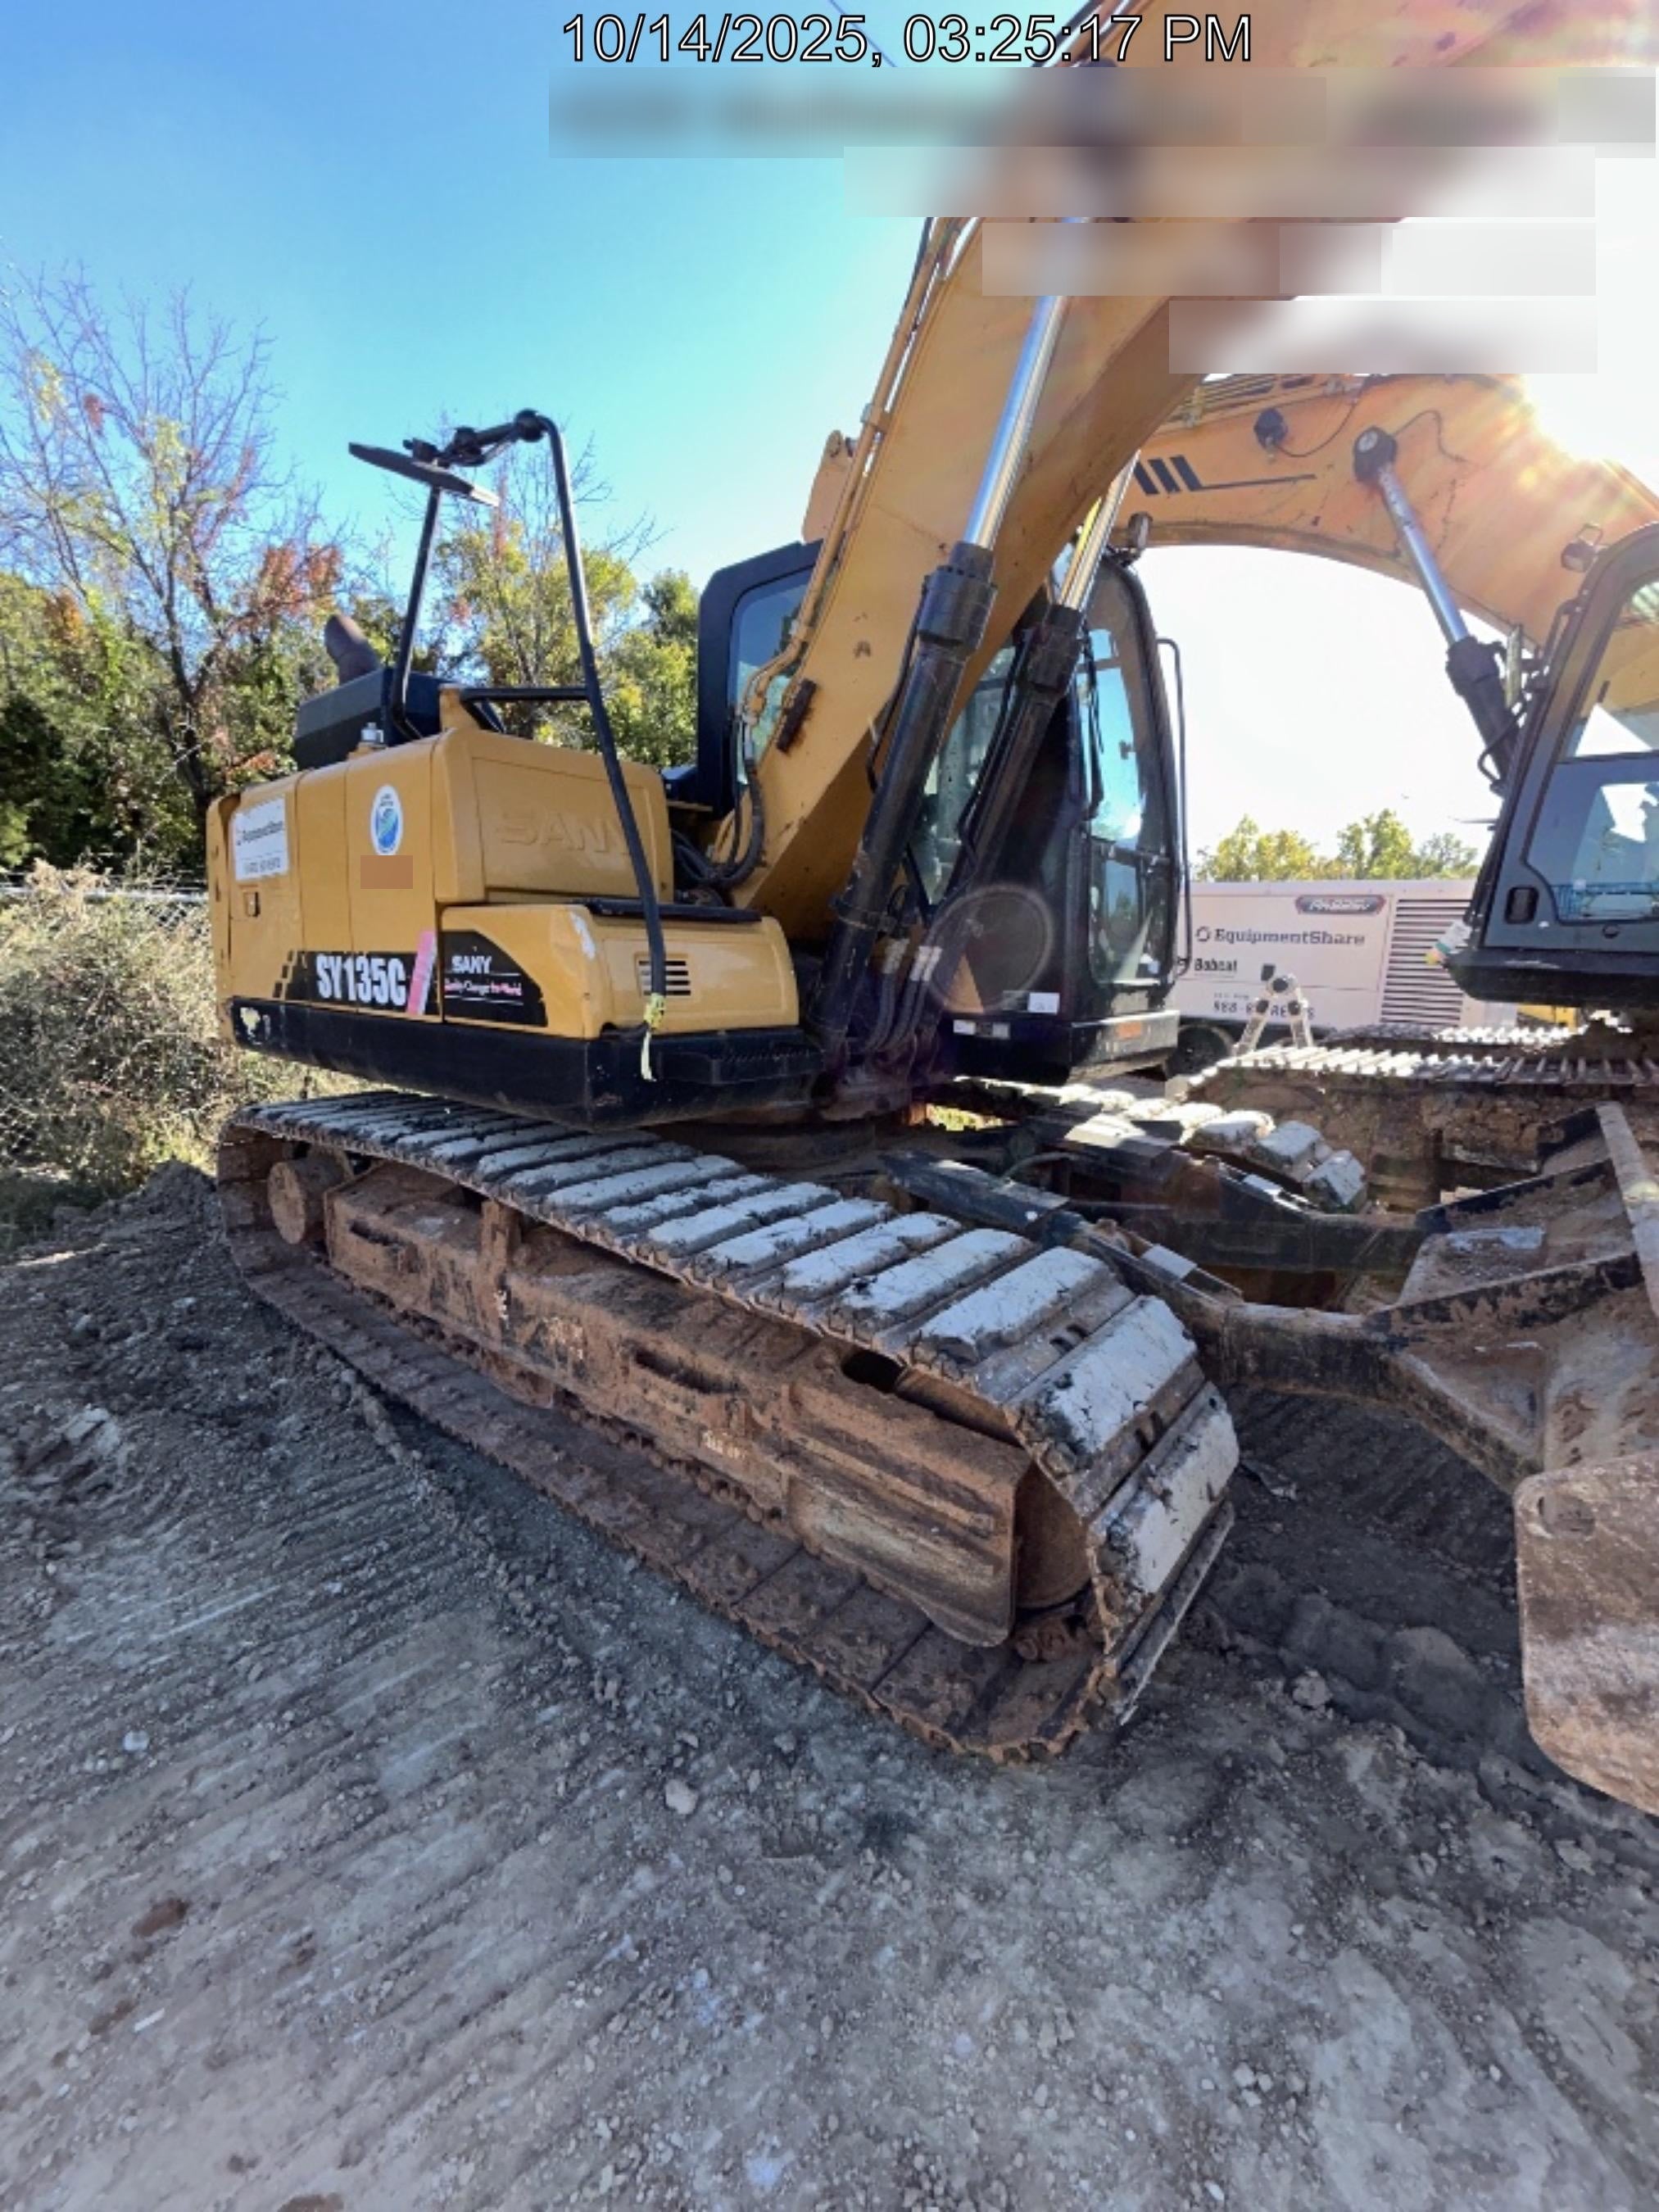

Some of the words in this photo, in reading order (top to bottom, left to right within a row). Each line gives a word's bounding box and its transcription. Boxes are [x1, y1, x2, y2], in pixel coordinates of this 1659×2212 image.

[1214, 927, 1366, 945] EquipmentShare
[451, 955, 492, 974] SANY
[316, 954, 406, 1006] SY135C
